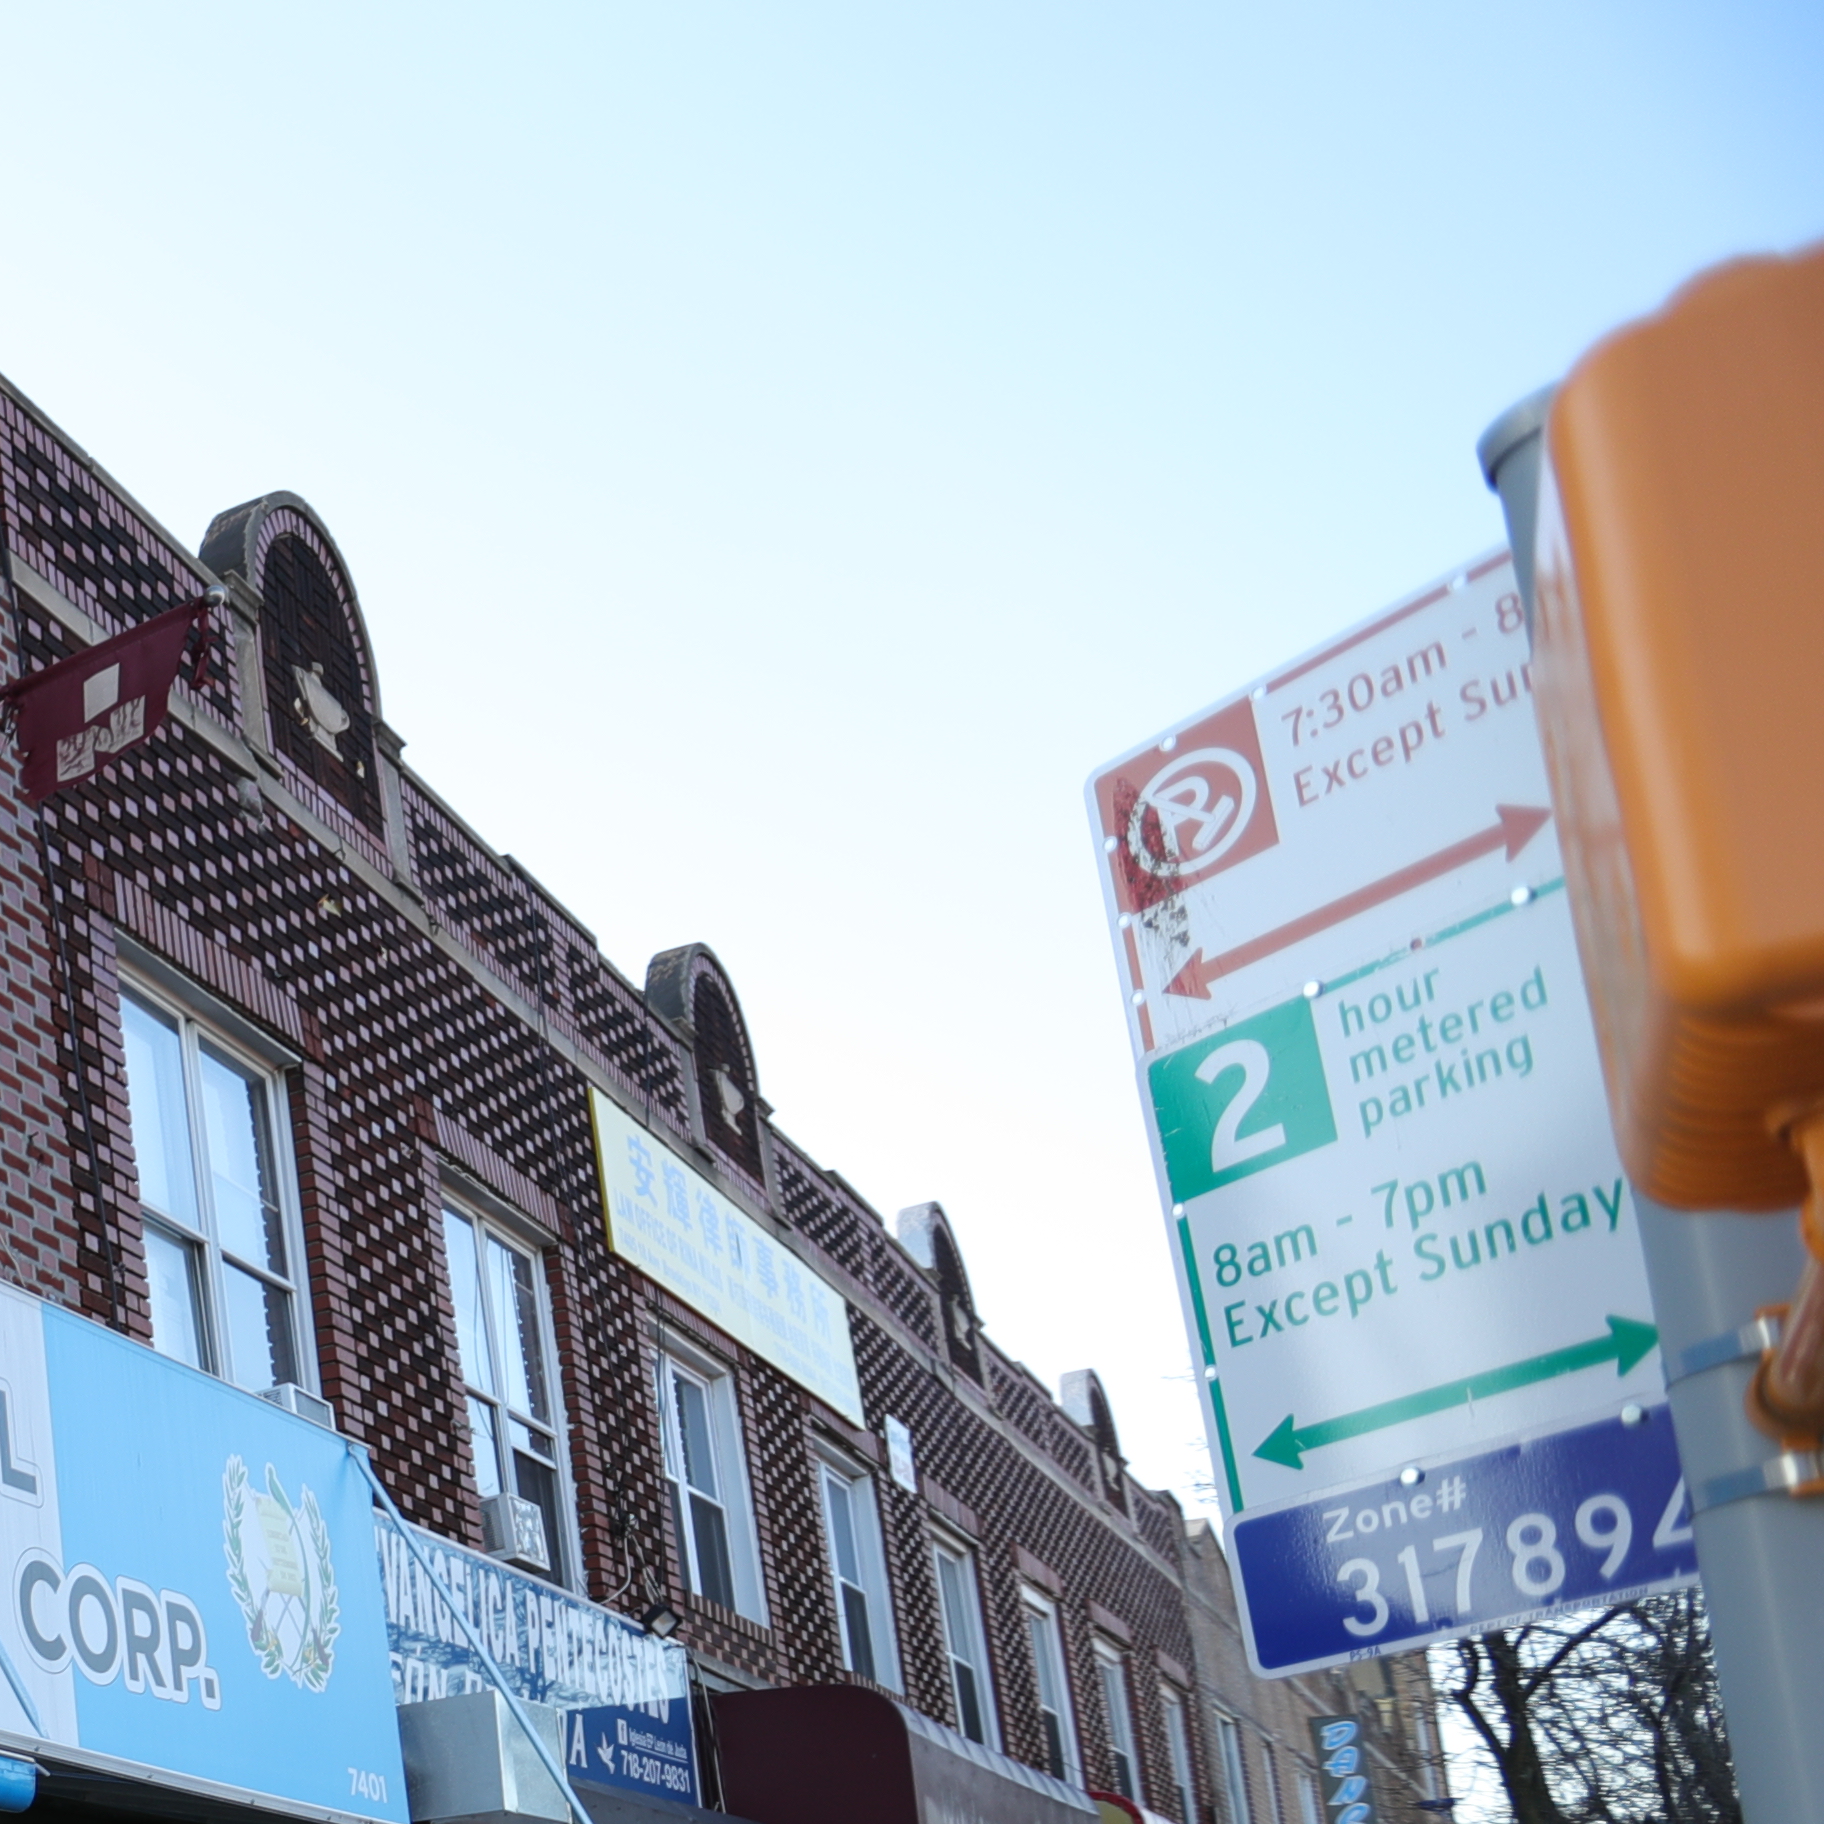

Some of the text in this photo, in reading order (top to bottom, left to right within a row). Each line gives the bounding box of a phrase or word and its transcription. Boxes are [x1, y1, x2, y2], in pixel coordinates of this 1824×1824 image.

[1279, 640, 1447, 748] 7:30am
[1291, 700, 1445, 808] Except
[1336, 967, 1440, 1037] hour
[1348, 964, 1550, 1084] metered
[1191, 1036, 1288, 1174] 2
[1357, 1027, 1536, 1138] parking
[1212, 1217, 1319, 1289] 8am
[1370, 1156, 1489, 1247] 7pm
[1223, 1175, 1626, 1350] Except Sunday
[1323, 1475, 1467, 1544] Zone#
[16, 1552, 222, 1704] CORP.
[348, 1767, 388, 1803] 7401
